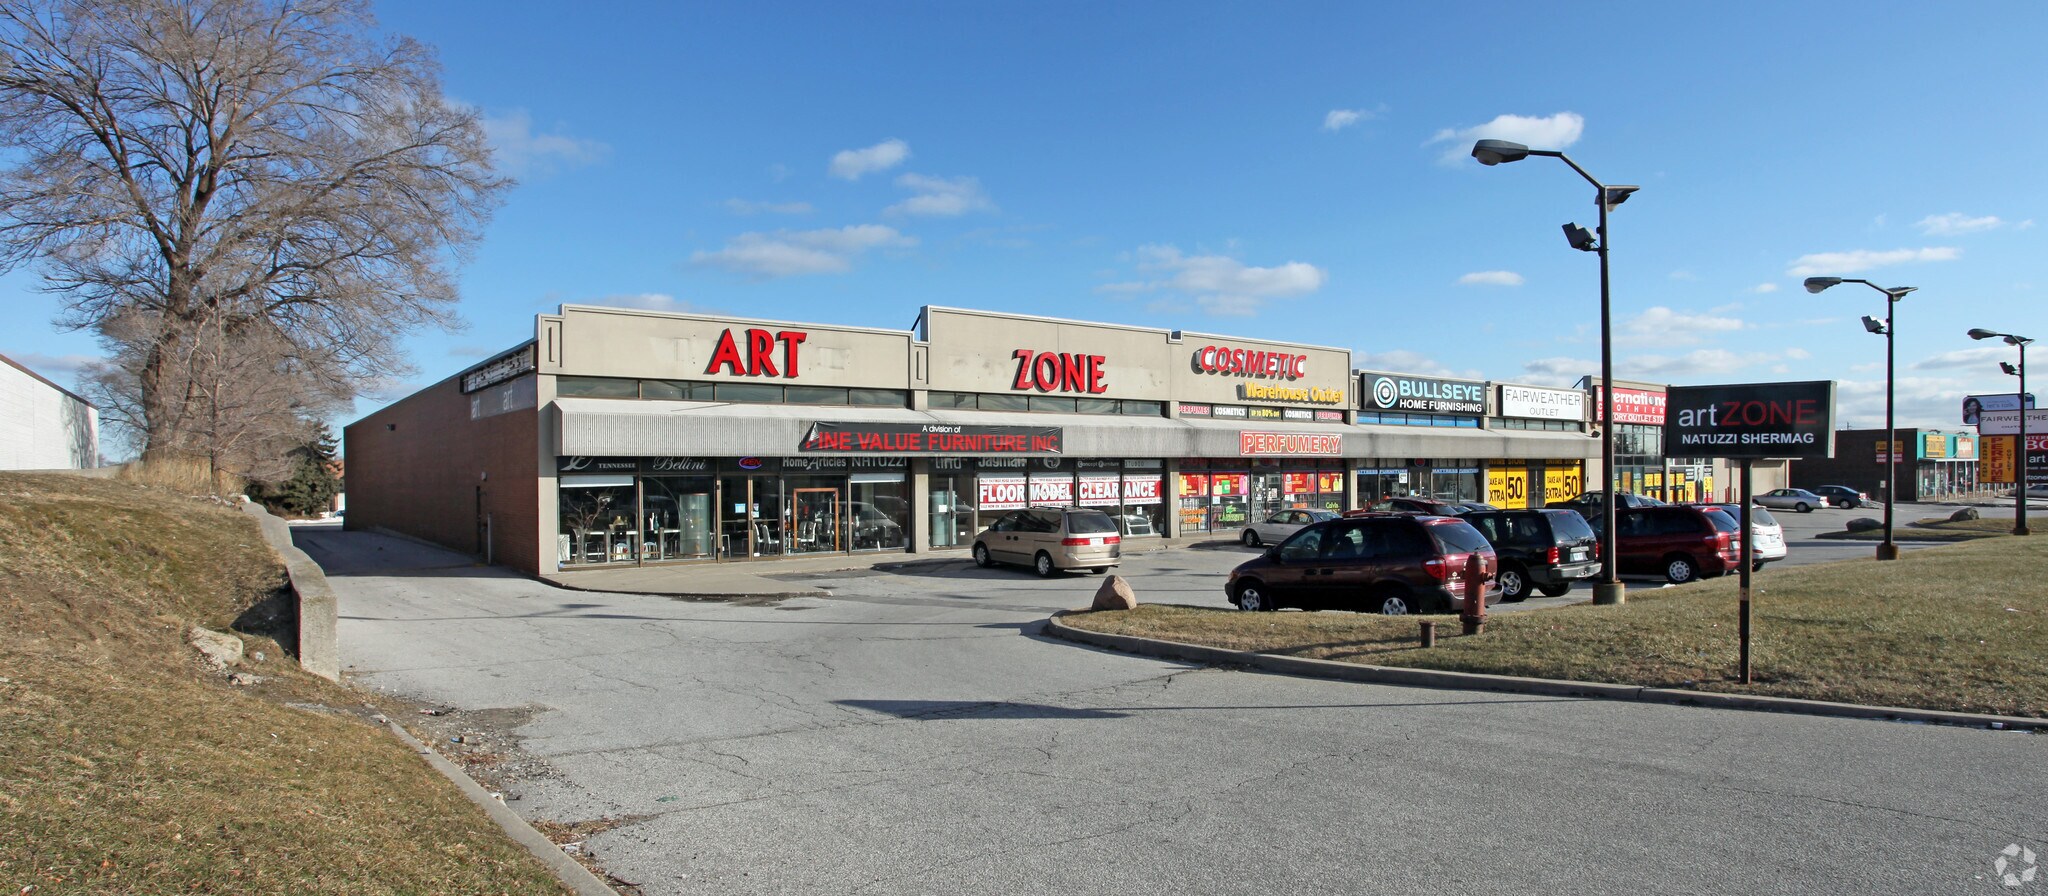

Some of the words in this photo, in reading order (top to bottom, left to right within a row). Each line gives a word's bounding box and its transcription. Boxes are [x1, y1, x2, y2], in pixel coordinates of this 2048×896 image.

[707, 327, 808, 377] ART
[1199, 345, 1307, 379] COSMETIC
[1015, 349, 1109, 394] ZONE
[1244, 381, 1309, 402] Warehouse
[1311, 385, 1344, 403] Outlet
[1400, 380, 1482, 401] BULLSEYE
[1505, 388, 1581, 407] FAIRWEATHER
[1179, 405, 1210, 415] PERFUMES
[1214, 406, 1246, 417] COSMETICS
[1261, 409, 1273, 418] 80%
[1285, 409, 1312, 419] COSMETICS
[1316, 411, 1343, 420] PERFUMES
[1400, 399, 1427, 410] HOME
[1428, 401, 1482, 413] FURNISHING
[1529, 407, 1560, 417] OUTLET
[1598, 402, 1664, 414] COTHIER
[1597, 412, 1627, 421] FORY
[1627, 413, 1651, 421] OUTLET
[1980, 414, 2048, 422] FAIRWETHE
[929, 425, 953, 433] division
[953, 425, 961, 433] of
[857, 433, 921, 450] VALUE
[928, 433, 1027, 451] FURNITURE
[1031, 435, 1058, 451] INC
[1243, 433, 1341, 454] PERFUMERY
[1682, 433, 1737, 444] NATUZZI
[1741, 432, 1814, 444] SHERMAG
[652, 456, 706, 470] Bellini
[783, 456, 808, 467] Home
[806, 456, 846, 470] Articles
[851, 457, 907, 467] NATUZZI
[1990, 437, 2003, 482] PERFUME
[2029, 454, 2046, 463] art
[1547, 476, 1556, 484] TAKE
[979, 484, 1025, 503] FLOOR
[1030, 482, 1073, 501] MODEL
[1488, 489, 1505, 502] XTRA
[1546, 488, 1562, 499] EXTRA
